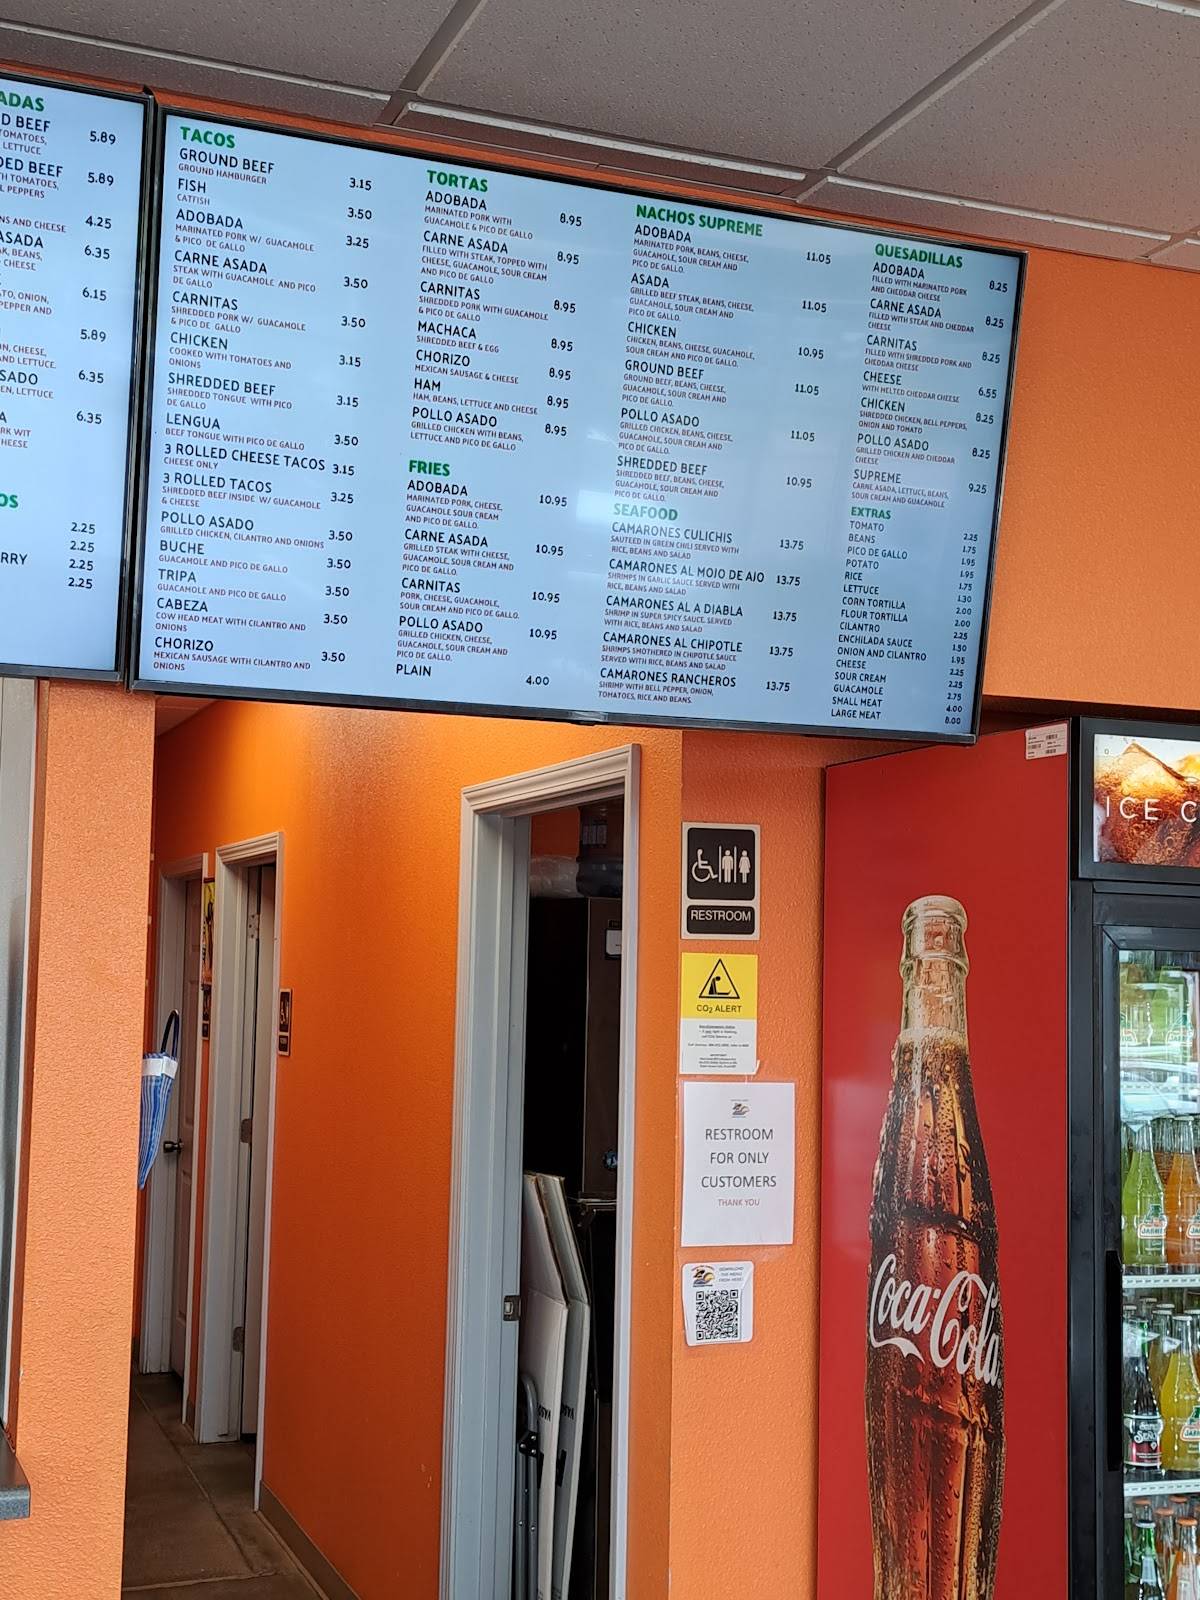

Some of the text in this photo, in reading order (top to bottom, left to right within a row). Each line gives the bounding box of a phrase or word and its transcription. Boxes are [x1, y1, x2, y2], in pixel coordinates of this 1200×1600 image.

[16, 116, 50, 132] BEEF
[90, 130, 116, 144] 5.89
[180, 126, 235, 148] TACOS
[3, 142, 41, 155] LETTUCE
[179, 147, 274, 173] GROUND BEEF
[29, 161, 63, 178] BEEF
[178, 163, 266, 184] GROUND HAMBURGER
[88, 172, 114, 186] 5.89
[178, 177, 206, 193] FISH
[349, 177, 371, 191] 3.15
[426, 169, 488, 192] TORTAS
[425, 190, 486, 210] ADOBADA
[86, 216, 112, 229] 4.25
[176, 208, 242, 229] ADOBADA
[559, 212, 582, 226] 8.95
[636, 204, 762, 236] NACHOS SUPREME
[346, 235, 369, 248] 3.25
[634, 224, 691, 243] ADOBADA
[423, 230, 508, 254] CARNE ASADA
[84, 245, 110, 260] 6.35
[806, 252, 830, 264] 11.05
[874, 243, 962, 268] QUESADILLAS
[174, 250, 267, 274] CARNE ASADA
[872, 261, 924, 280] ADOBADA
[630, 272, 669, 288] ASADA
[988, 280, 1007, 292] 8.25
[82, 287, 107, 301] 6.15
[420, 281, 480, 300] CARNITAS
[172, 290, 237, 310] CARNITAS
[553, 299, 575, 313] 8.95
[870, 298, 941, 318] CARNE ASADA
[417, 320, 476, 339] MACHACA
[627, 321, 676, 338] CHICKEN
[170, 331, 227, 350] CHICKEN
[866, 334, 916, 351] CARNITAS
[416, 349, 470, 366] CHORIZO
[798, 347, 823, 359] 10.95
[78, 370, 104, 384] 6.35
[414, 364, 448, 375] MEXICAN
[449, 368, 482, 379] SAUSAGE
[492, 374, 518, 384] CHEESE
[549, 367, 570, 380] 8.95
[625, 359, 704, 379] GROUND BEEF
[168, 372, 275, 396] SHREDDED BEEF
[414, 377, 440, 392] HAM
[863, 370, 902, 385] CHEESE
[860, 396, 905, 412] CHICKEN
[166, 412, 220, 430] LENGUA
[412, 406, 497, 427] POLLO ASADO
[621, 407, 699, 427] POLLO ASADO
[975, 412, 993, 424] 8.25
[544, 423, 566, 436] 8.95
[857, 433, 928, 451] POLLO ASADO
[164, 443, 325, 470] 3 ROLLED CHEESE TACOS
[332, 463, 354, 476] 3.15
[409, 459, 450, 477] FRIES
[617, 455, 707, 475] SHREDDED BEEF
[163, 472, 271, 493] 3 ROLLED TACOS
[853, 468, 901, 484] SUPREME
[407, 479, 467, 496] ADOBADA
[968, 482, 986, 494] 9.25
[539, 494, 566, 506] 10.95
[614, 503, 678, 520] SEAFOOD
[850, 506, 891, 520] EXTRAS
[71, 522, 96, 534] 2.25
[161, 510, 253, 531] POLLO ASADO
[849, 520, 884, 532] TOMATO
[328, 530, 352, 541] 3.50
[404, 528, 488, 547] CARNE ASADA
[612, 521, 732, 543] CAMARONES CULICHIS
[848, 533, 875, 544] BEANS
[160, 539, 204, 555] BUCHE
[780, 539, 803, 550] 13.75
[847, 546, 907, 559] PICO DE GALLO
[157, 568, 196, 582] TRIPA
[609, 558, 677, 574] CAMARONES
[680, 565, 693, 576] AL
[728, 569, 743, 580] DE
[844, 571, 862, 581] RICE
[68, 578, 92, 589] 2.25
[401, 577, 460, 593] CARNITAS
[156, 597, 208, 612] CABEZA
[532, 591, 559, 603] 10.95
[842, 596, 905, 609] CORN TORTILLA
[606, 595, 742, 616] CAMARONES AL A DIABLA
[399, 615, 482, 632] POLLO ASADO
[604, 618, 622, 626] WITH
[623, 620, 640, 629] RICE,
[641, 621, 663, 630] BEANS
[680, 624, 702, 632] SALAD
[155, 636, 213, 651] CHORIZO
[603, 631, 742, 652] CAMARONES AL CHIPOTLE
[321, 651, 345, 662] 3.50
[396, 663, 431, 676] PLAIN
[600, 667, 736, 687] CAMARONES RANCHEROS
[834, 671, 886, 682] SOUR CREAM
[526, 675, 549, 686] 4.00
[766, 681, 790, 691] 13.75
[1106, 796, 1162, 820] ICE
[690, 910, 751, 922] RESTROOM
[705, 1128, 774, 1141] RESTROOM
[710, 1152, 769, 1165] FOR ONLY
[701, 1176, 776, 1188] CUSTOMERS
[718, 1198, 743, 1206] THANK
